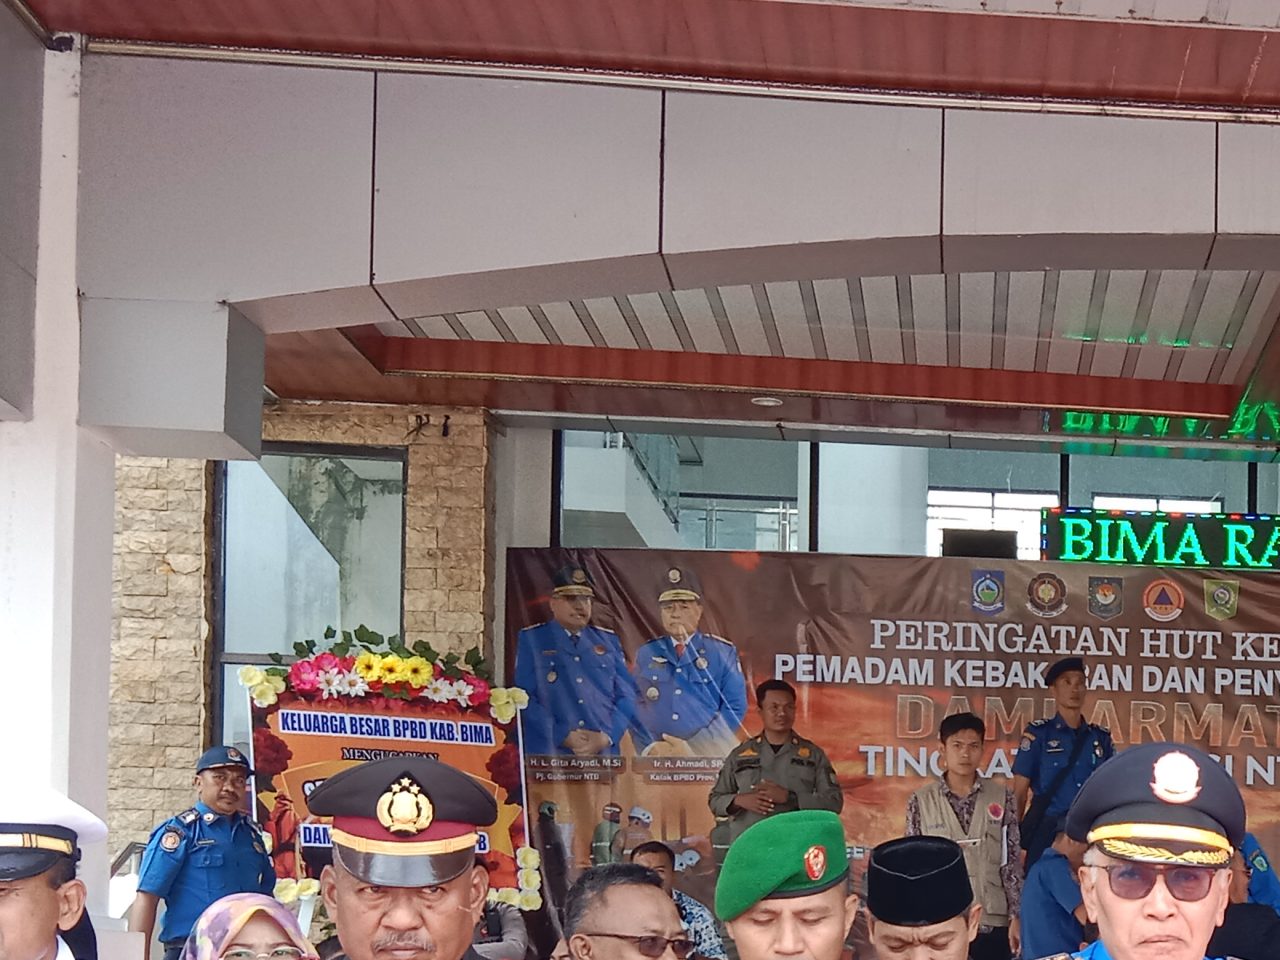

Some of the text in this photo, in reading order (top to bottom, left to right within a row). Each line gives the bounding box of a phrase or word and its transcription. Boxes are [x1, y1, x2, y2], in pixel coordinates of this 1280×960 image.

[1059, 517, 1210, 565] BIMA
[870, 619, 1129, 657] PERINGATAN
[1140, 628, 1222, 662] HUT
[775, 653, 933, 686] PEMADAM
[945, 659, 1132, 691] KEBAKAN
[1142, 665, 1205, 694] DAN
[281, 711, 493, 744] KELUARGA BESAR BPBD KAB. BIMA
